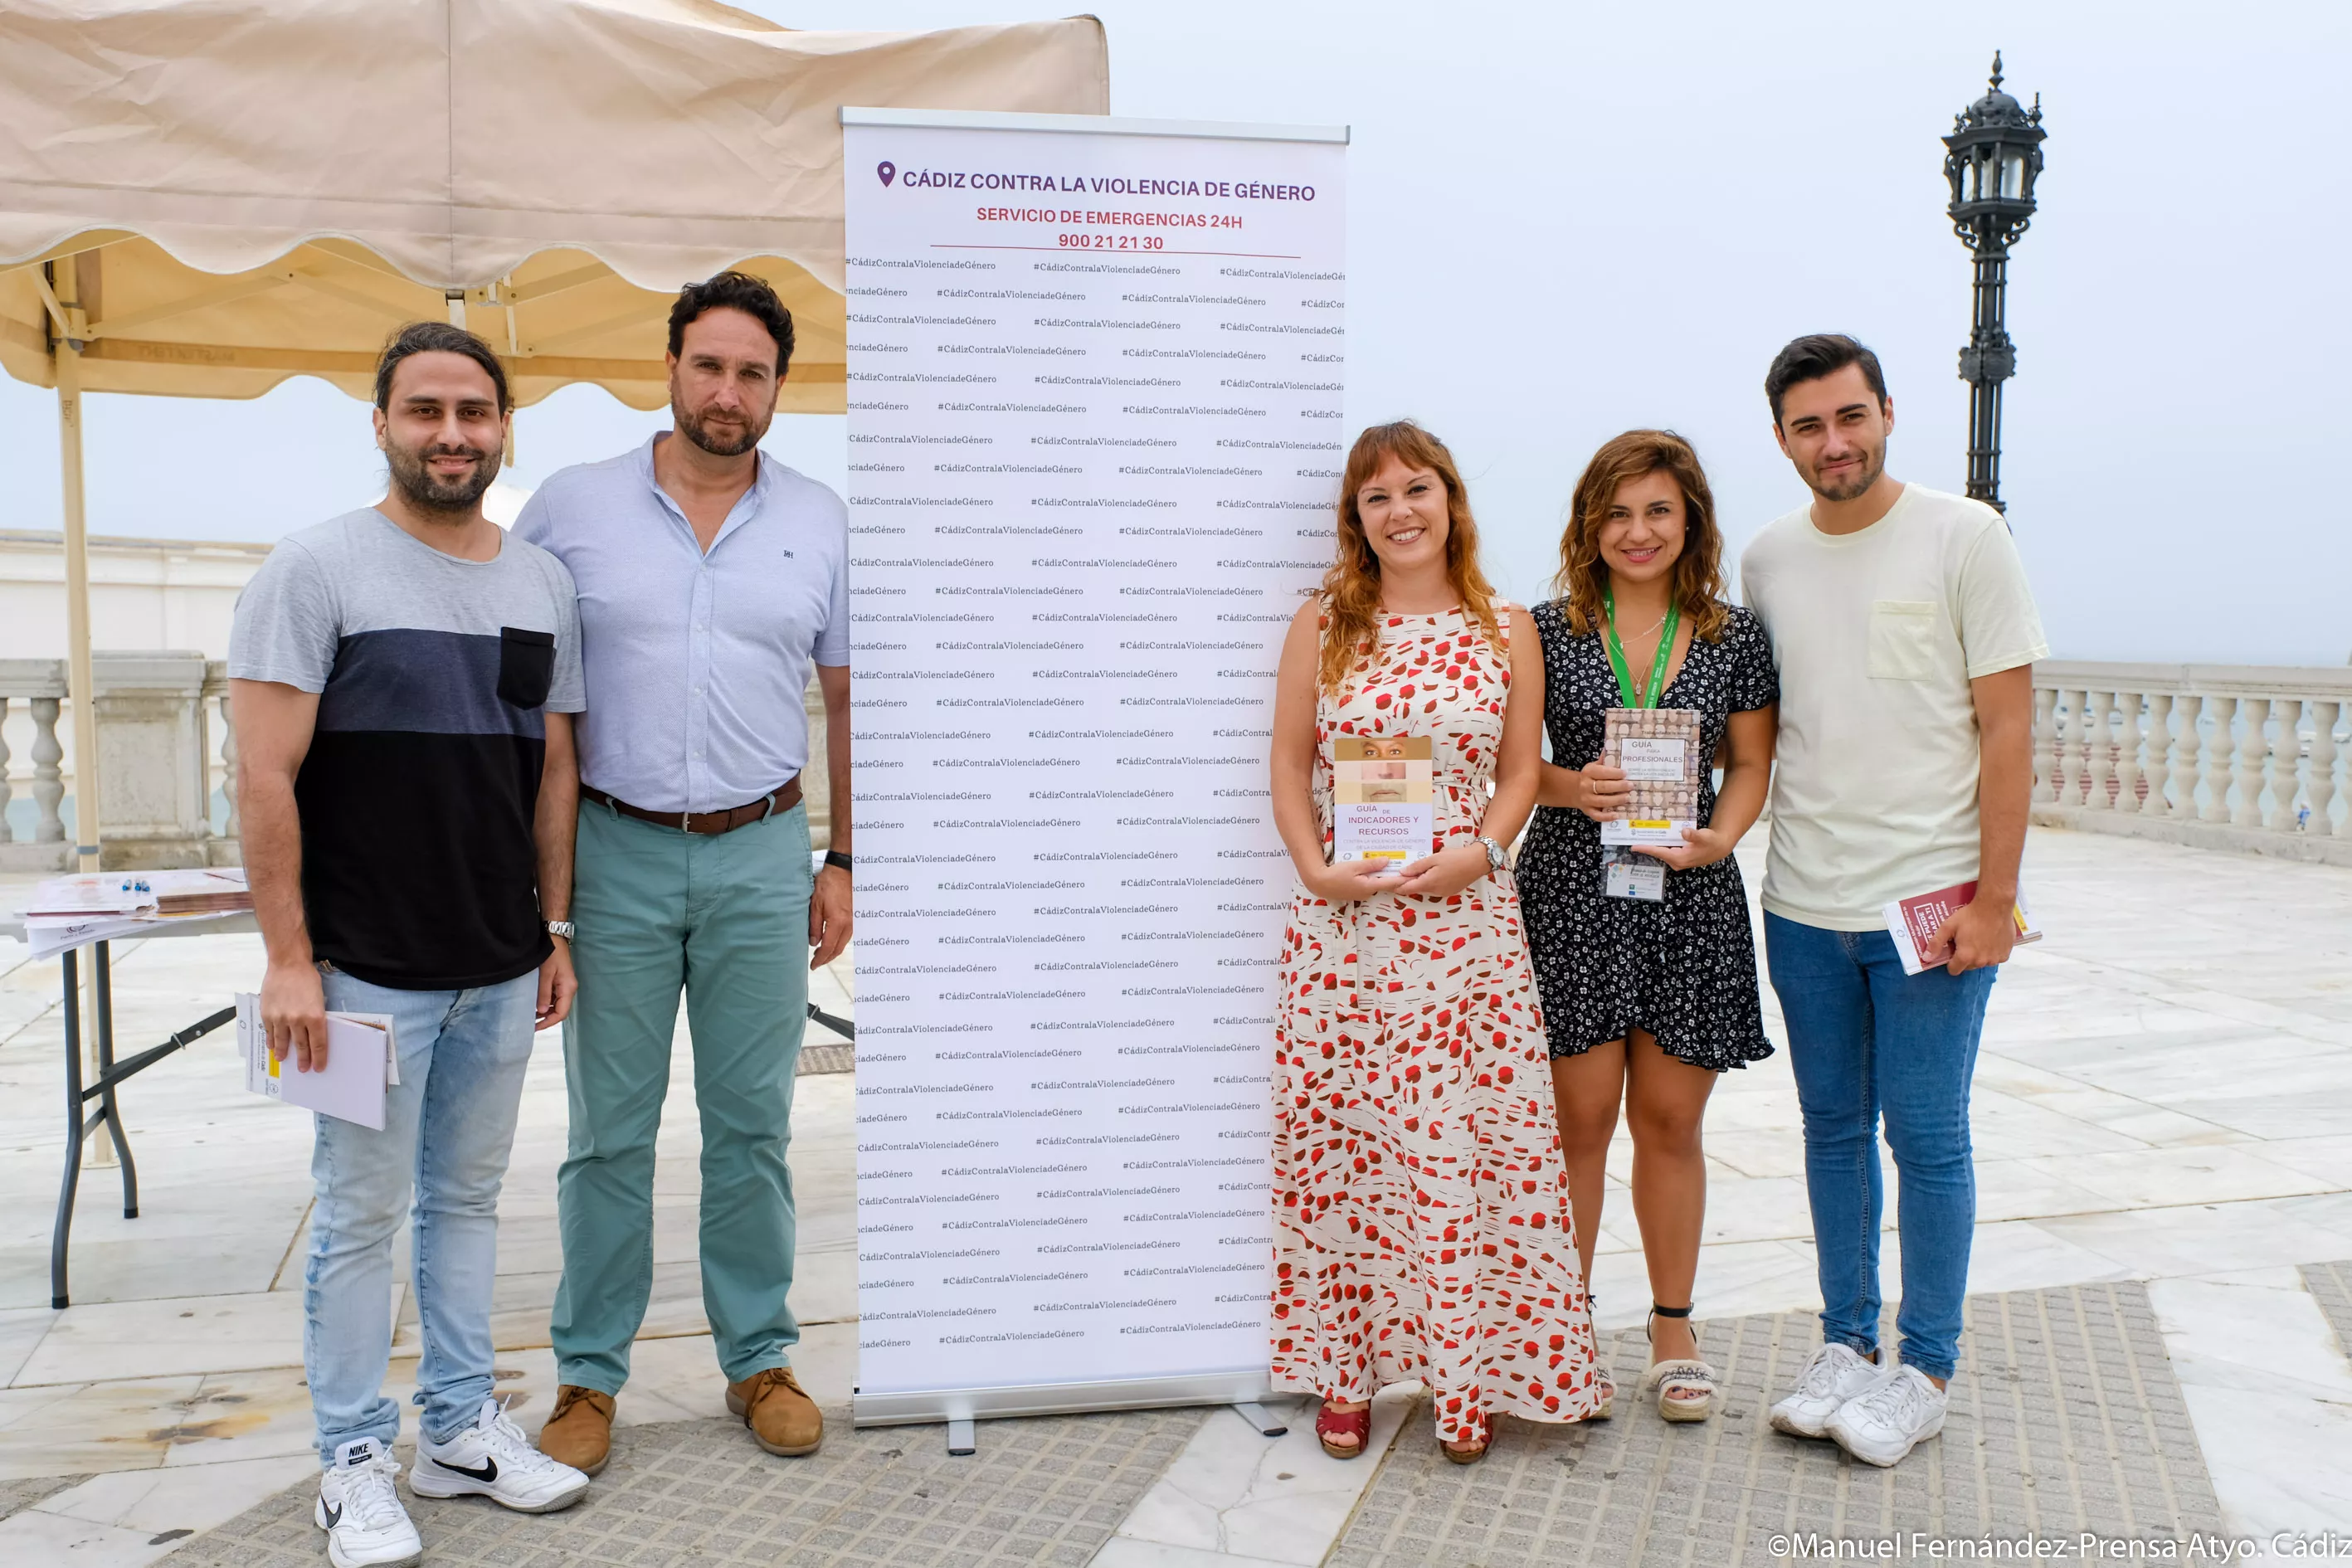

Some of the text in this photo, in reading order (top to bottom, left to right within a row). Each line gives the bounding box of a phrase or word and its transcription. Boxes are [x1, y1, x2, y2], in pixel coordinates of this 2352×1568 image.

[903, 168, 1316, 201] CÁDIZ CONTRA LA VIOLENCIA DE GÉNERO
[977, 207, 1243, 229] SERVICIO DE EMERGENCIAS 24H
[1059, 234, 1164, 249] 900 21 21 30
[1033, 262, 1181, 276] #CádizContralaViolenciadeGénero
[936, 288, 1267, 306] #CádizContralaViolenciadeGénero #CádizContralaViolenciadeGénero
[1033, 318, 1181, 330] #CádizContralaViolenciadeGénero
[937, 344, 1267, 360] #CádizContralaViolenciadeGénero #CádizContralaViolenciadeGénero
[1034, 374, 1181, 387] #CádizContralaViolenciadeGénero
[937, 402, 1267, 416] #CádizContralaViolenciadeGénero #CádizContralaViolenciadeGénero
[848, 433, 993, 445] CádizContralaViolenciadeGénero
[1030, 436, 1177, 447] #CádizContralaViolenciadeGénero
[933, 463, 1263, 476] #CádizContralaViolenciadeGénero #CádizContralaViolenciadeGénero
[848, 495, 994, 506] CádizContralaViolenciadeGénero
[1030, 497, 1177, 508] #CádizContralaViolenciadeGénero
[934, 524, 1264, 537] #CádizContralaViolenciadeGénero #CádizContralaViolenciadeGénero
[1031, 558, 1178, 568] #CádizContralaViolenciadeGénero
[935, 586, 1264, 598] #CádizContralaViolenciadeGénero #CádizContralaViolenciadeGénero
[1031, 612, 1178, 622] #CádizContralaViolenciadeGénero
[1216, 612, 1295, 622] #CádizContralaVio
[935, 640, 1264, 650] #CádizContralaViolenciadeGénero #CádizContralaViolenciadeGénero
[850, 668, 1278, 679] CádizContralaViolenciadeGénero #CádizContralaViolenciadeGénero #CádizContral
[936, 696, 1264, 707] #CádizContralaViolenciadeGénero #CádizContralaViolenciadeGénero
[1028, 728, 1174, 739] #CádizContralaViolenciadeGénero
[932, 756, 1260, 767] #CádizContralaViolenciadeGénero #CádizContralaViolenciadeGénero
[1029, 789, 1174, 800] #CádizContralaViolenciadeGénero
[1356, 804, 1377, 812] GUÍA
[933, 816, 1260, 829] #CádizContralaViolenciadeGénero #CádizContralaViolenciadeGénero
[1033, 850, 1179, 861] #CádizContralaViolenciadeGénero
[937, 876, 1264, 890] #CádizContralaViolenciadeGénero #CádizContralaViolenciadeGénero
[1033, 903, 1179, 915] #CádizContralaViolenciadeGénero
[1919, 911, 1931, 934] PUEDE
[937, 929, 1264, 945] #CádizContralaViolenciadeGénero #CádizContralaViolenciadeGénero
[1034, 959, 1179, 971] #CádizContralaViolenciadeGénero
[938, 984, 1264, 1001] #CádizContralaViolenciadeGénero #CádizContralaViolenciadeGénero
[1030, 1018, 1175, 1030] #CádizContralaViolenciadeGénero
[935, 1043, 1260, 1060] #CádizContralaViolenciadeGénero #CádizContralaViolenciadeGénero
[1030, 1077, 1176, 1090] #CádizContralaViolenciadeGénero
[935, 1101, 1261, 1120] #CádizContralaViolenciadeGénero #CádizContralaViolenciadeGénero
[1035, 1132, 1181, 1146] #CádizContralaViolenciadeGénero
[941, 1157, 1265, 1176] #CádizContralaViolenciadeGénero #CádizContralaViolenciadeGénero
[1036, 1185, 1181, 1199] #CádizContralaViolenciadeGénero
[1218, 1181, 1272, 1191] #CádizContr
[942, 1208, 1265, 1230] #CádizContralaViolenciadeGénero #CádizContralaViolenciadeGénero
[1036, 1239, 1181, 1254] #CádizContralaViolenciadeGénero
[942, 1262, 1265, 1285] #CádizContralaViolenciadeGénero #CádizContralaViolenciadeGénero
[1033, 1298, 1177, 1312] #CádizContralaViolenciadeGénero
[938, 1320, 1262, 1345] #CádizContralaViolenciadeGénero #CádizContralaViolenciadeGénero
[348, 1443, 369, 1458] NIKE
